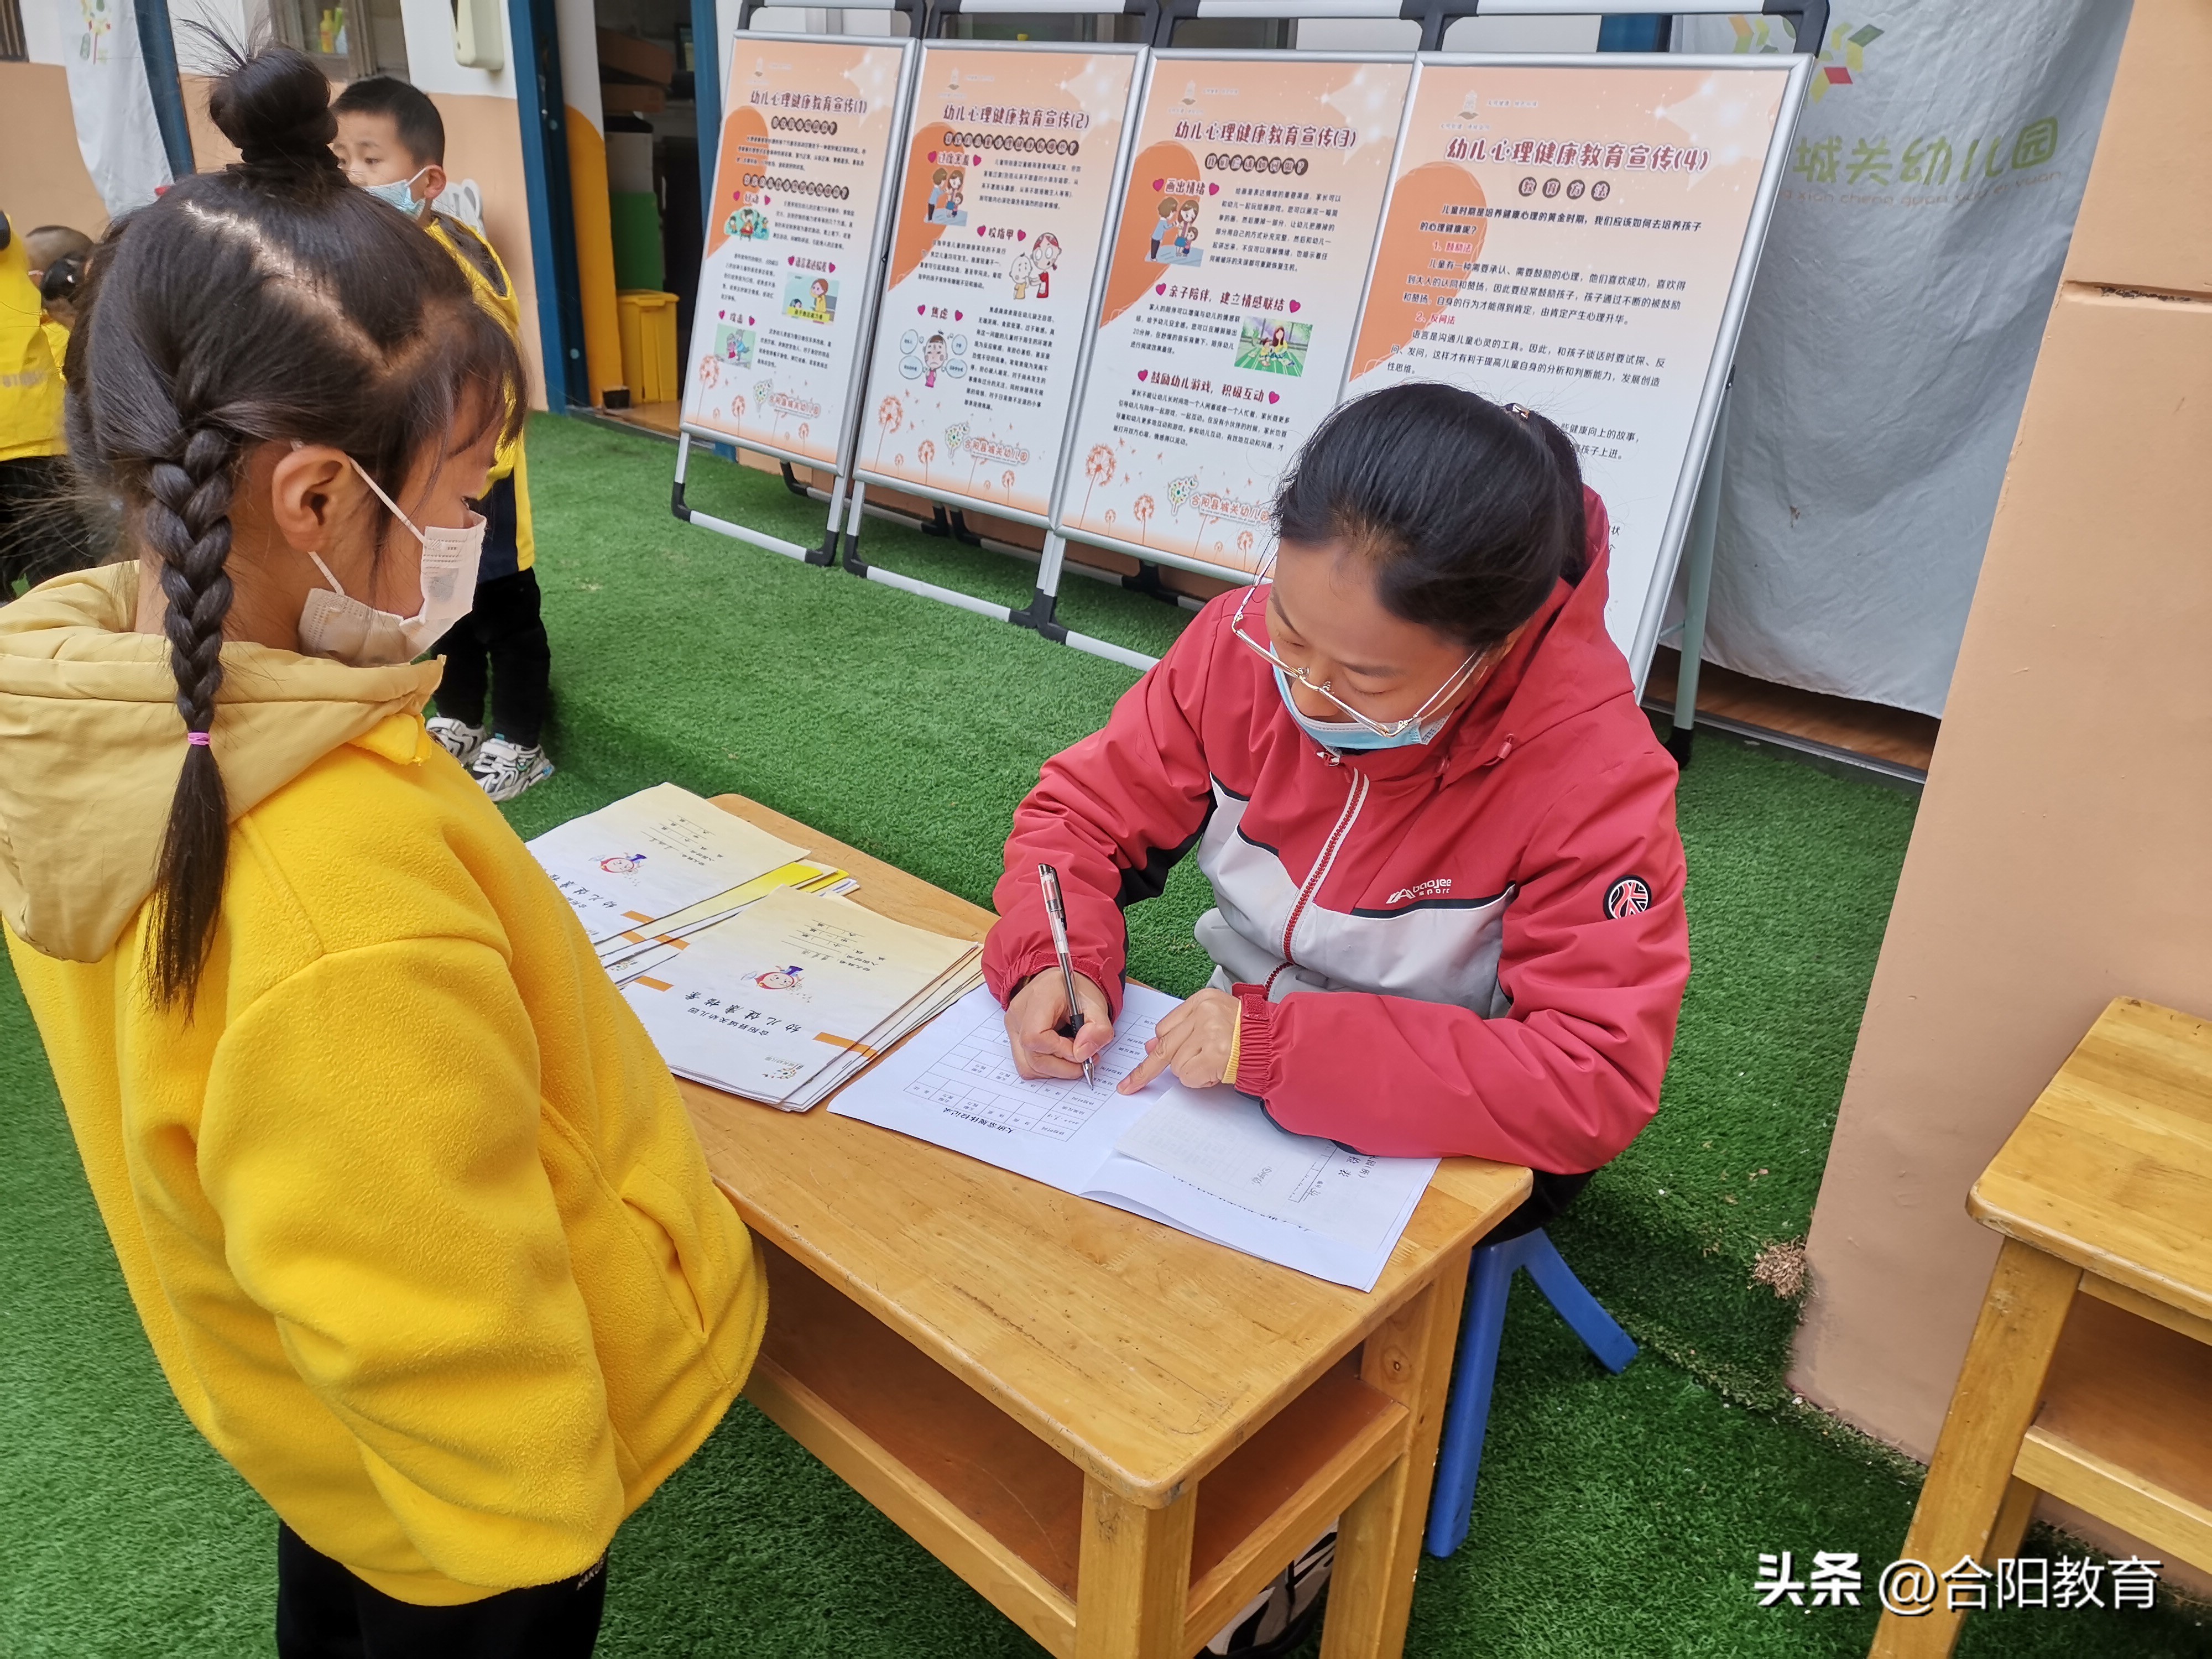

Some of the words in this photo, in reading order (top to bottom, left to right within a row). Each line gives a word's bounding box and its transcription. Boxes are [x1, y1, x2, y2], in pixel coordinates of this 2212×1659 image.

[750, 90, 867, 113] 幼儿心理健康教育宣传(1)
[943, 105, 1090, 129] 幼儿心理健康教育宣传(2)
[1175, 121, 1356, 147] 幼儿心理健康教育宣传(3)
[1447, 138, 1710, 173] 幼儿心理健康教育宣传(4)
[1792, 116, 2058, 187] 城关幼儿园
[1165, 179, 1206, 195] 画出情绪
[1798, 191, 1834, 202] xian
[1841, 193, 1893, 207] cheng
[1901, 193, 1948, 207] guan
[2016, 171, 2061, 187] yuan
[1442, 205, 1702, 232] 儿童时期是培养健康心理的黄金时期，我们应该如何去培养孩子
[988, 227, 1014, 240] 咬指甲
[1433, 241, 1473, 253] 1、鼓励法
[1428, 259, 1686, 291] 儿童有一种需要承认、需要鼓励的心理，他们喜欢成功，喜欢得
[1169, 284, 1285, 312] 亲子陪伴，建立情感联结
[1407, 275, 1681, 311] 到大人的认同和赞扬，因此要经常鼓励孩子，孩子通过不断的被鼓励
[1403, 293, 1628, 325] 和赞扬，自身的行为才能得到肯定，由肯定产生心理升华。
[1416, 312, 1456, 325] 2、反问法
[1412, 330, 1666, 368] 语言是沟通儿童心灵的工具。因此，和孩子谈话时要试探、反
[1387, 362, 1415, 374] 性思维。
[1390, 345, 1661, 388] 问、发问，这样才有利于提高儿童自身的分析和判断能力，发展创造
[1151, 371, 1264, 403] 鼓励幼儿游戏，积极互动
[964, 439, 1027, 463] 合阳县城关幼儿园
[1413, 879, 1452, 894] baojee
[1419, 887, 1451, 896] sport
[685, 992, 802, 1033] 幼儿健康档案
[687, 1007, 769, 1036] 合阳县城关幼儿园
[943, 1108, 1016, 1134] 大班常规体检记录
